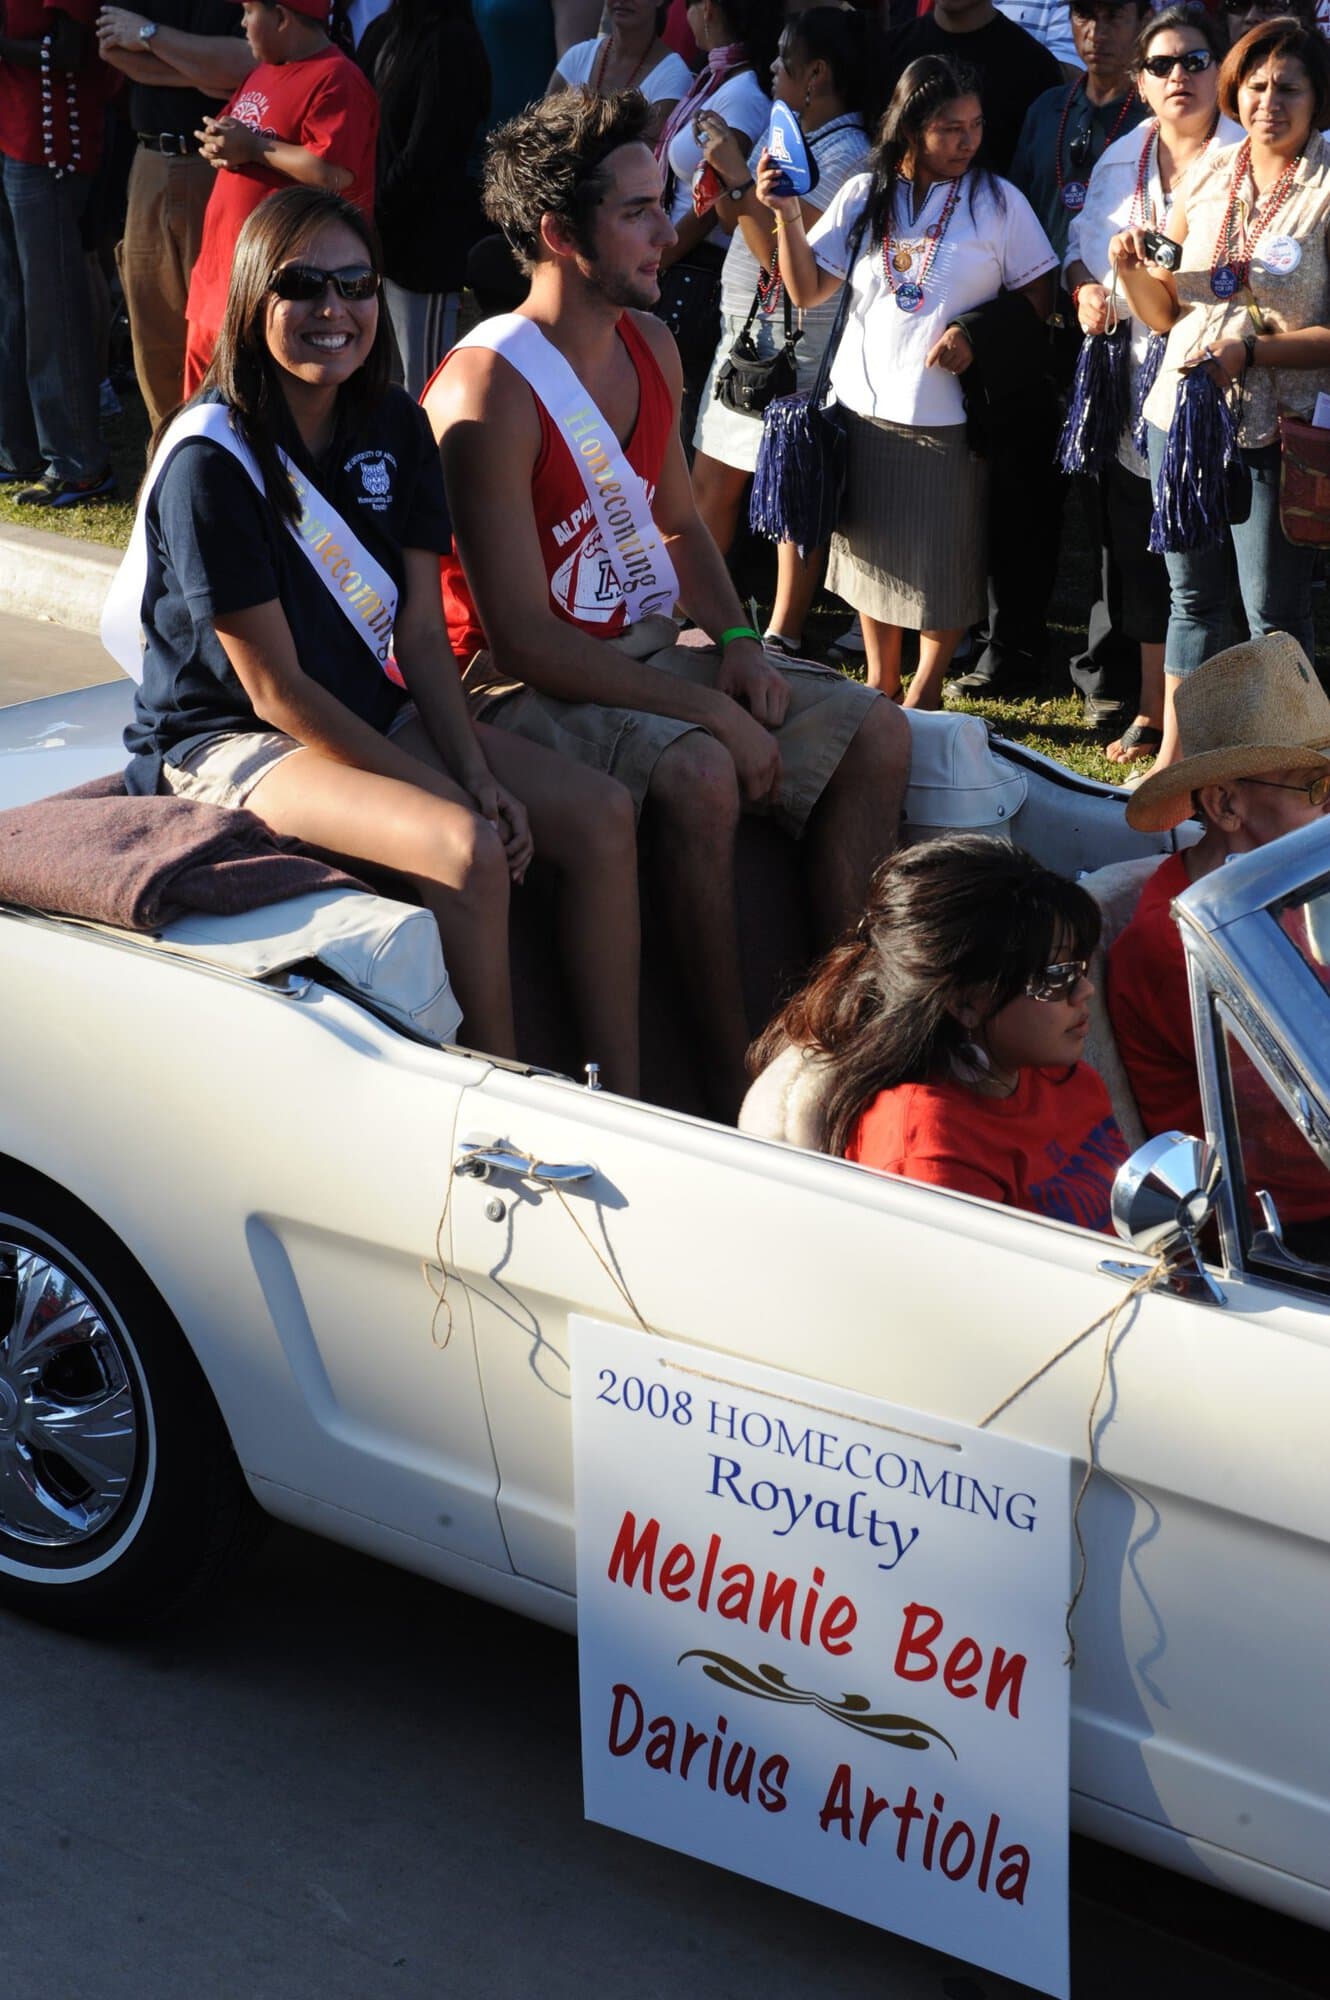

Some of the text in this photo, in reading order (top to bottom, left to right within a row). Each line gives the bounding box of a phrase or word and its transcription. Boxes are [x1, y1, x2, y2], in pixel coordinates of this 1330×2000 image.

[287, 474, 397, 660] omecoming
[551, 498, 595, 547] ALPH
[563, 408, 657, 593] Homecoming
[596, 1368, 1038, 1532] 2008 HOMECOMING
[705, 1452, 920, 1570] Royalty
[607, 1510, 1028, 1720] Melanie Ben
[608, 1683, 1032, 1906] Darius Artiola
